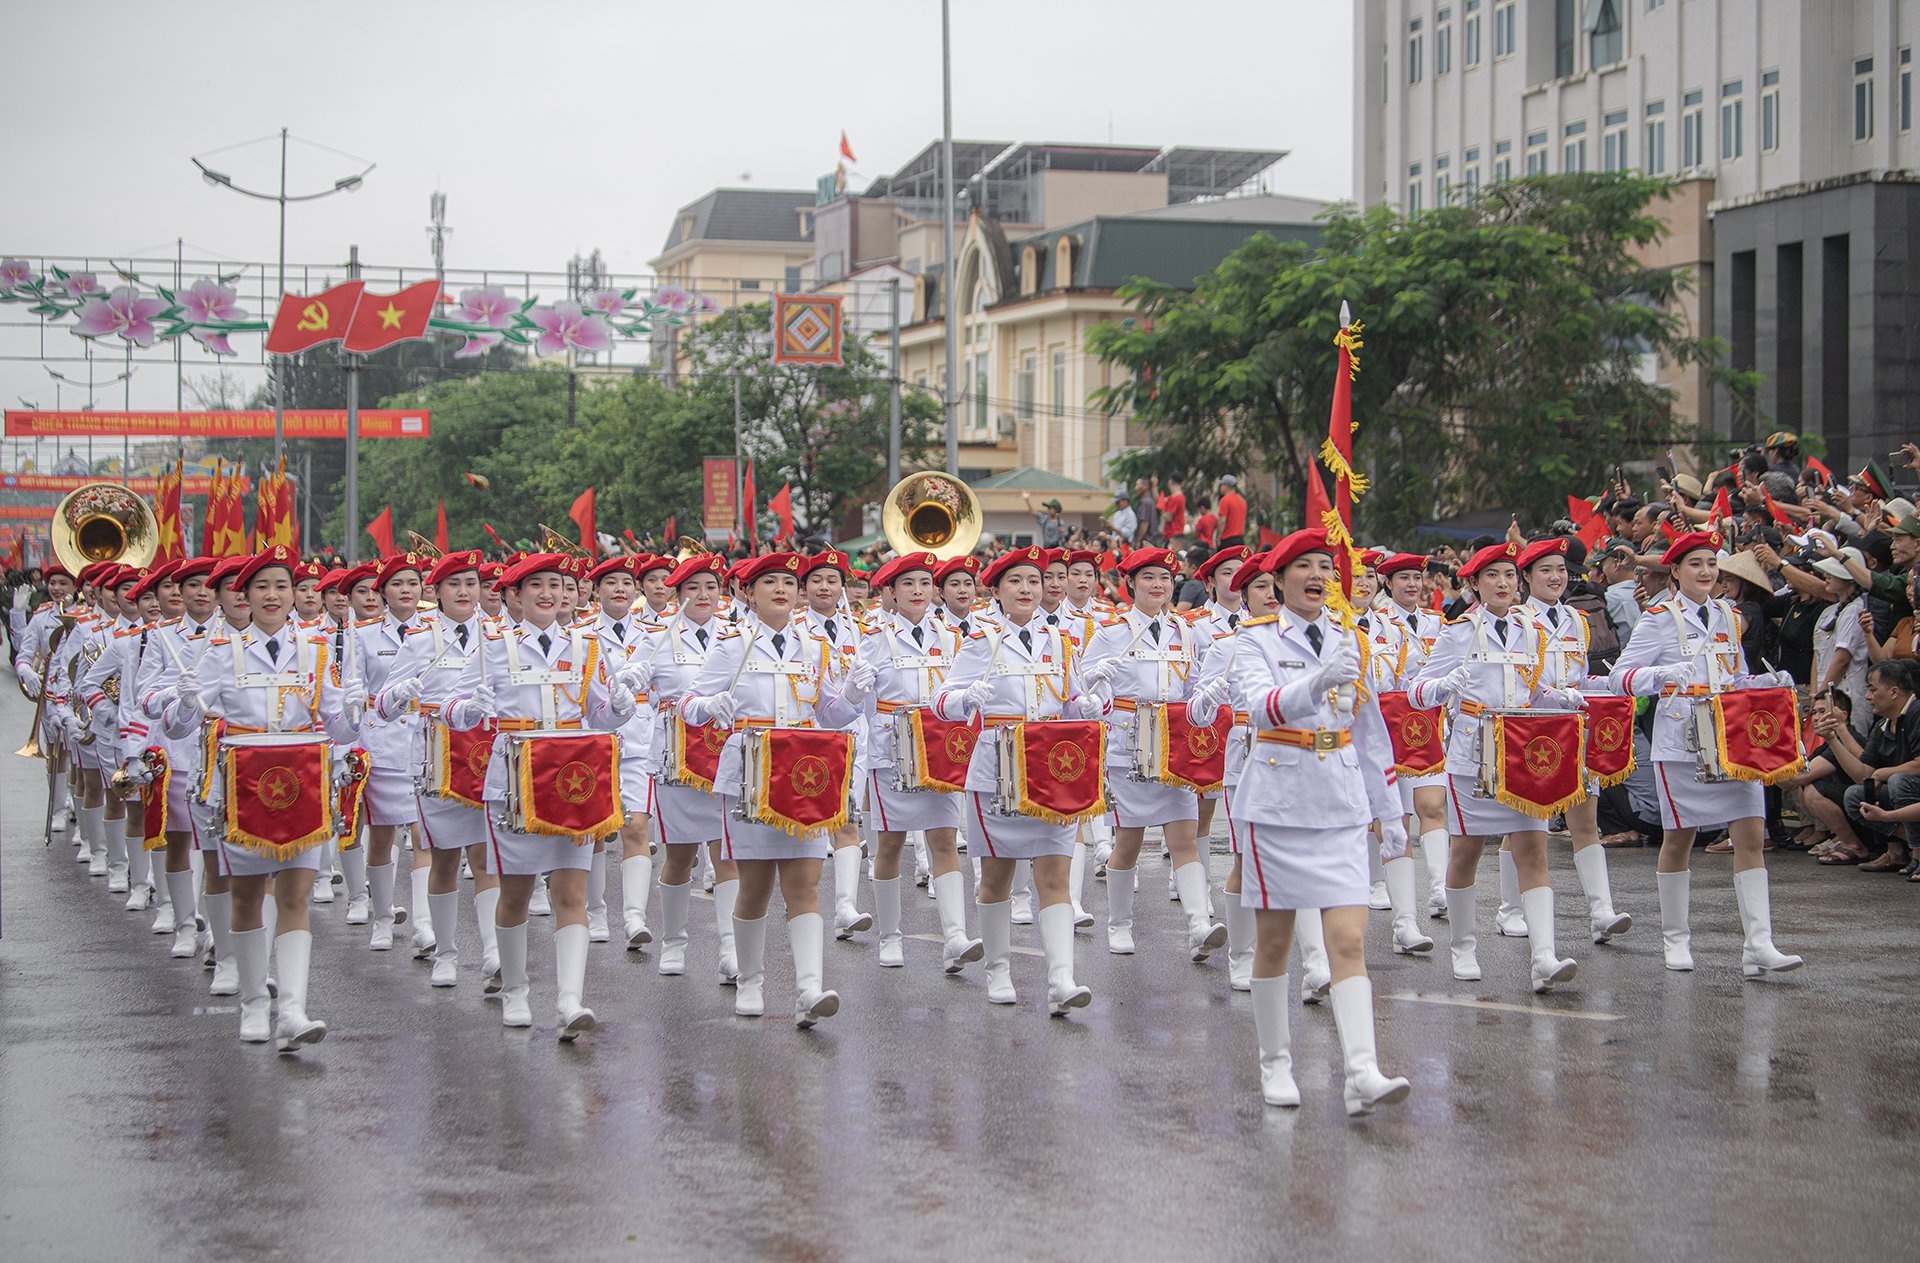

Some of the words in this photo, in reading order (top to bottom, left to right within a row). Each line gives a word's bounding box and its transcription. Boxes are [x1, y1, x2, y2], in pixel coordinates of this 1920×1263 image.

[32, 414, 64, 431] CHIẾN
[189, 413, 211, 431] MỘT
[231, 414, 254, 431] TÍCH
